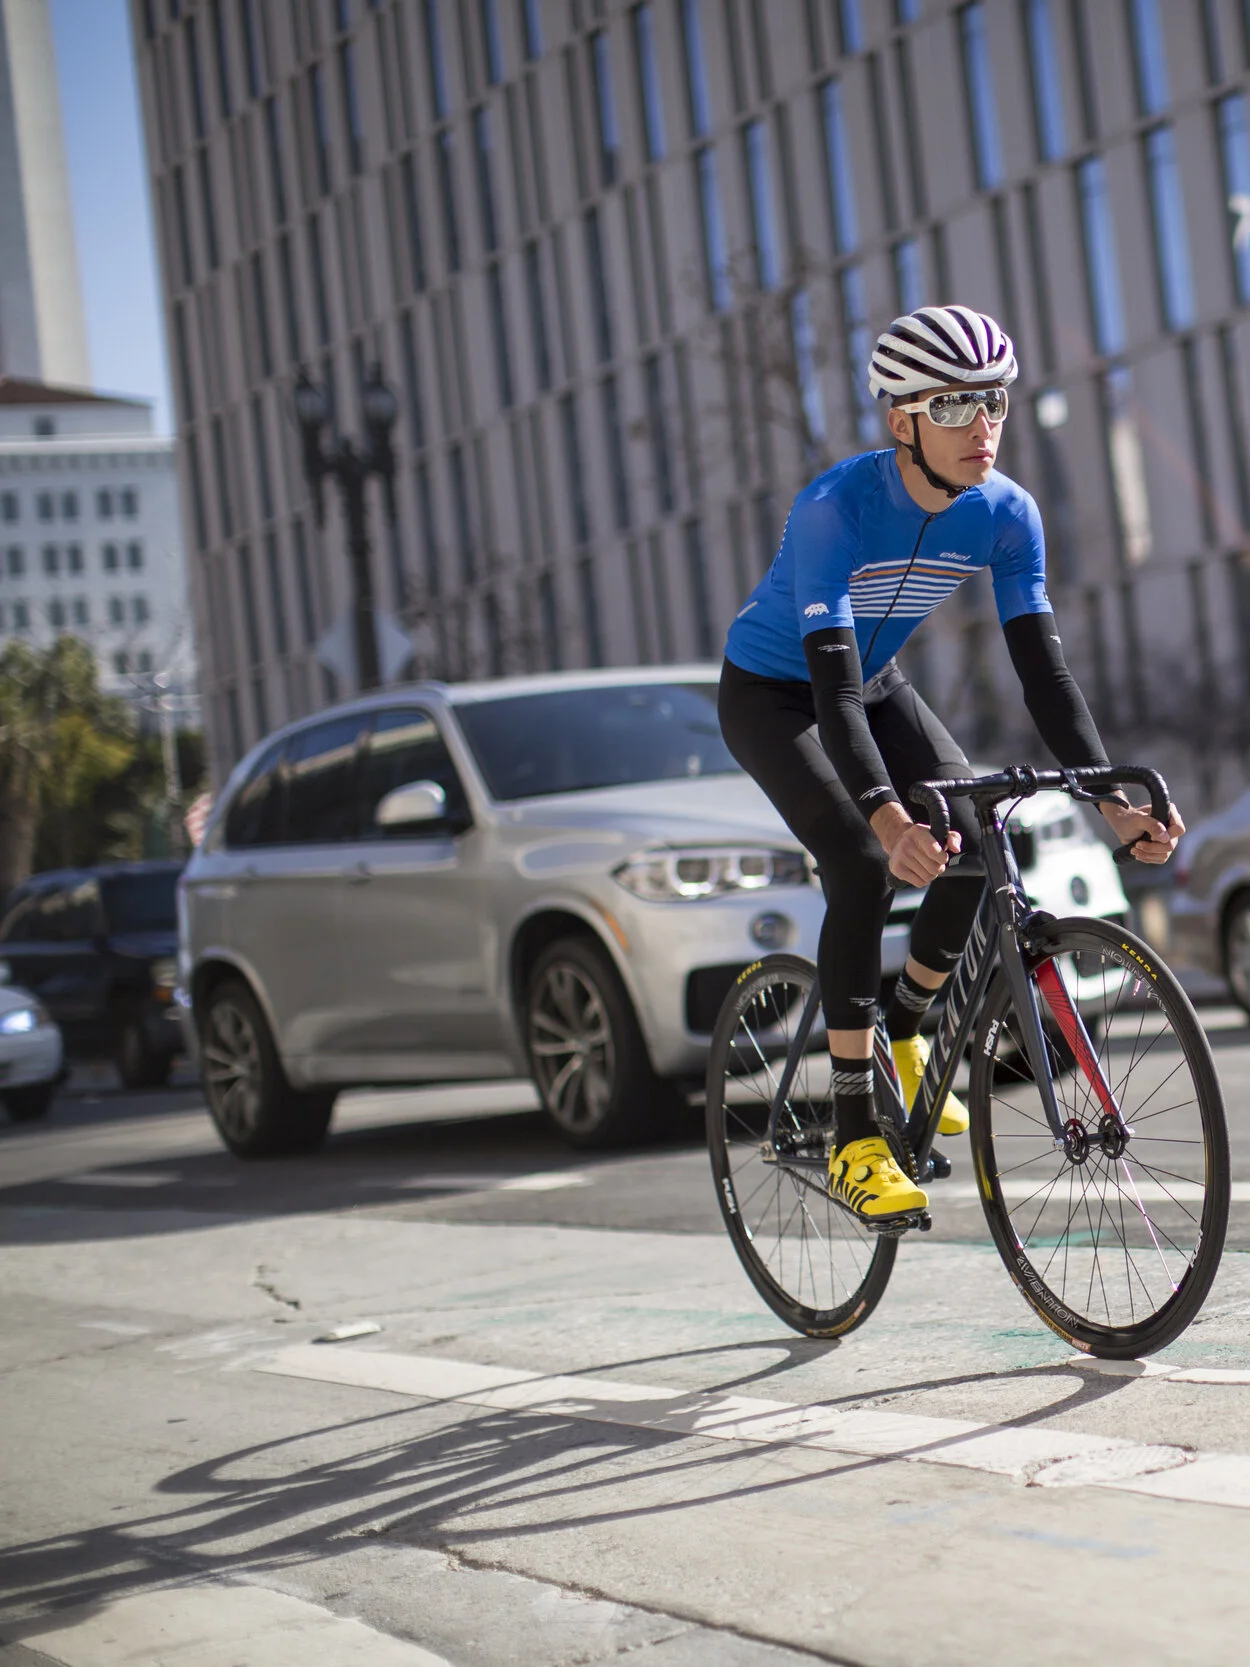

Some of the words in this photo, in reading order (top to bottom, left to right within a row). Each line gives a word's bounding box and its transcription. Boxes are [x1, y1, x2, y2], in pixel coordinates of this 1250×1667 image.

[1121, 943, 1158, 981] KENDA
[922, 911, 987, 1115] AVENTON
[983, 1018, 1000, 1057] PUSH
[1016, 1255, 1081, 1330] AVENTON
